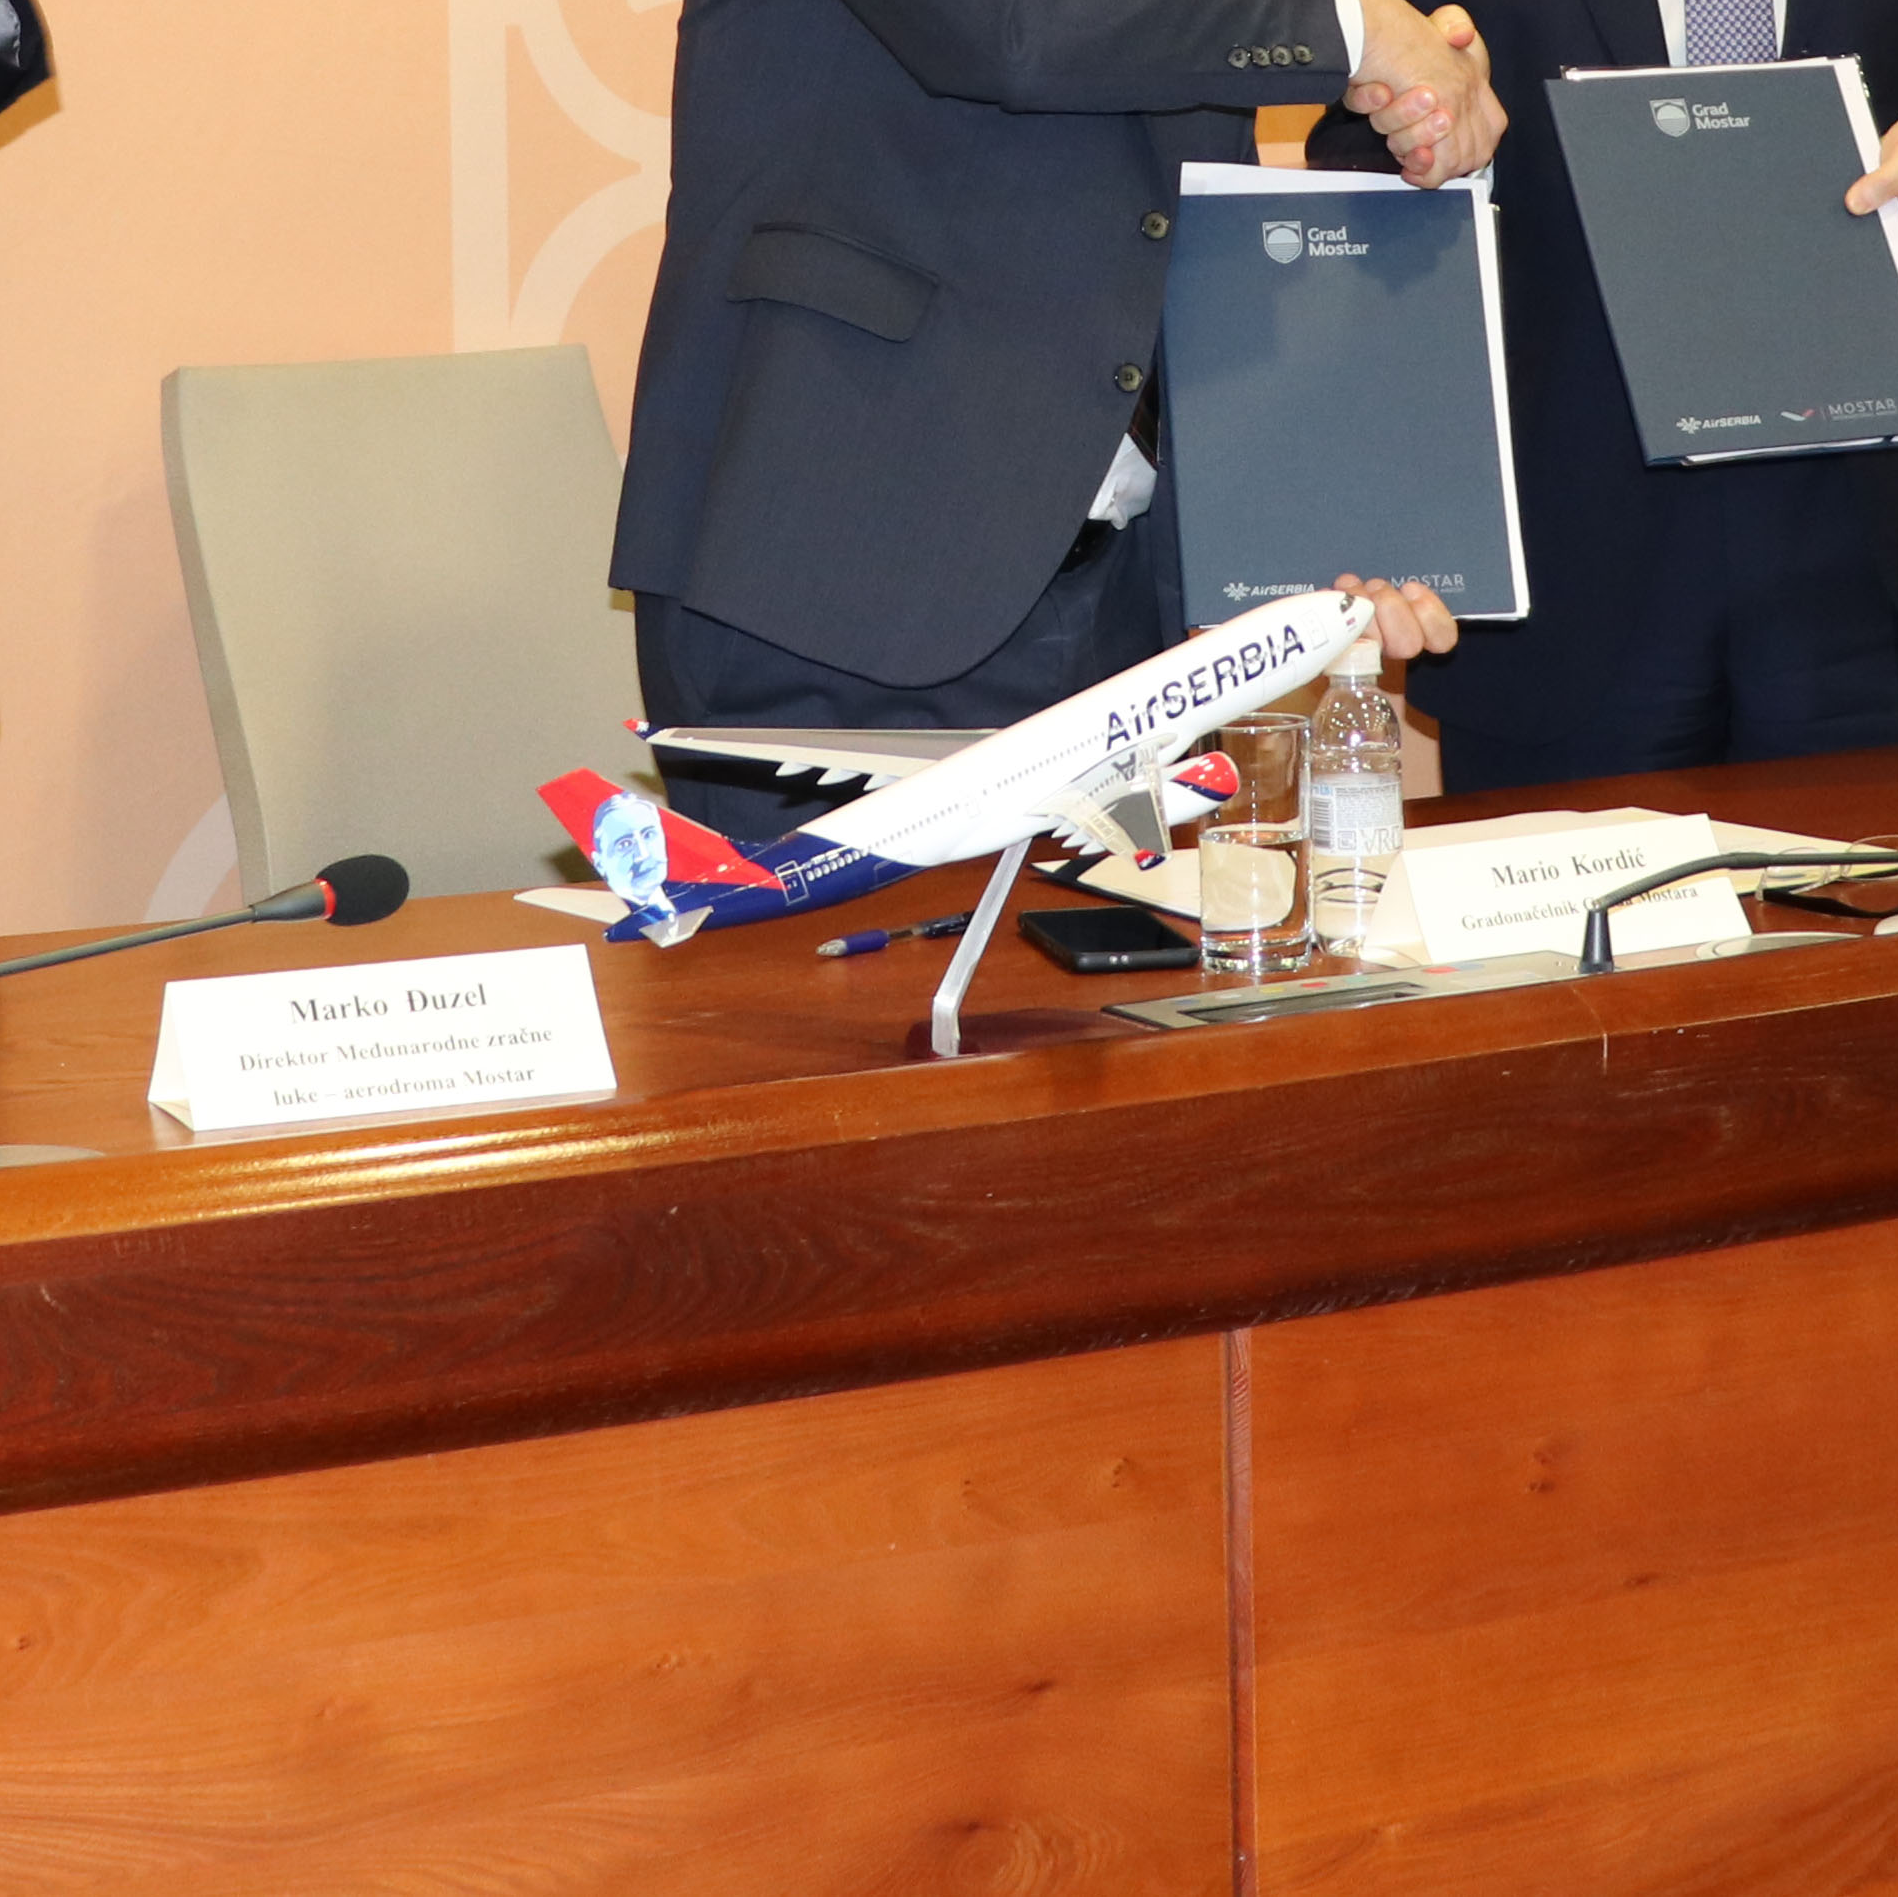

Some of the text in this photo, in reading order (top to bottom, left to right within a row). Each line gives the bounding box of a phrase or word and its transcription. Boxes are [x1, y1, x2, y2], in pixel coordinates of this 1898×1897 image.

[1692, 102, 1729, 116] Grad
[1694, 116, 1750, 130] Mostar
[1307, 226, 1347, 241] Grad
[1308, 242, 1369, 256] Mostar
[1828, 398, 1896, 415] MOSTAR
[1701, 415, 1762, 429] AirSERBIA
[1251, 584, 1315, 596] AirSERBIA
[1106, 625, 1305, 751] AirSERBIA
[1491, 847, 1648, 888] Mario Kordić
[1462, 898, 1580, 931] Gradonačelnik
[1638, 886, 1699, 904] Mostara
[289, 983, 488, 1024] Marko Đuzel
[239, 1046, 329, 1071] Direktor
[487, 1026, 553, 1048] zračne
[274, 1088, 318, 1108] luke
[344, 1077, 456, 1100] aerodroma
[463, 1067, 535, 1088] Mostar
